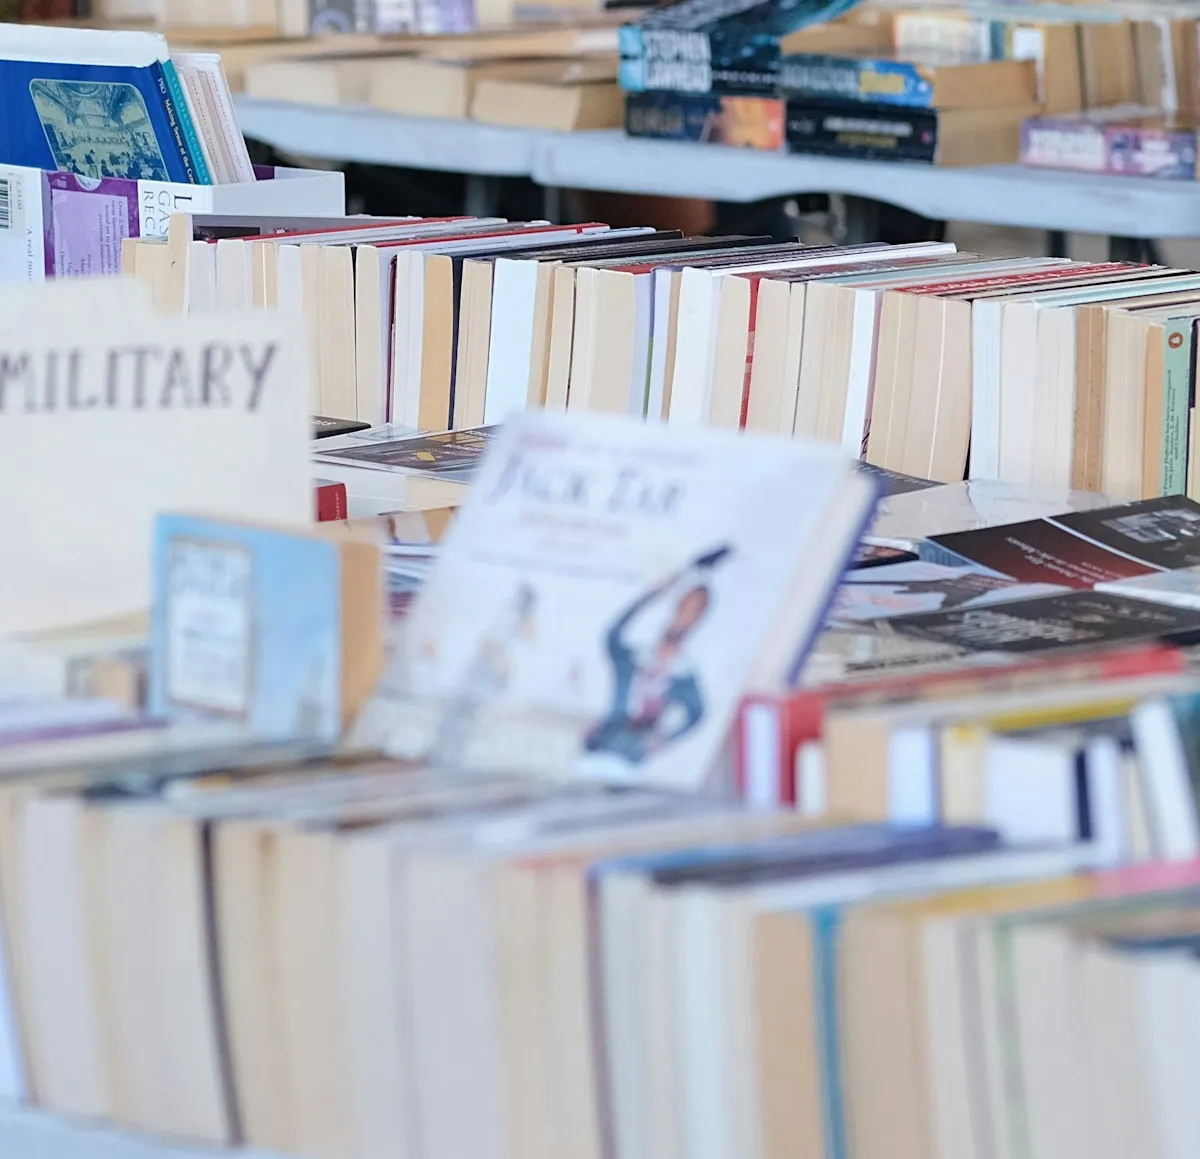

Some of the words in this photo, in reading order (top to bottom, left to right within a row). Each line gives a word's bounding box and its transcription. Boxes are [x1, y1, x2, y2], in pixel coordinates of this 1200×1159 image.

[164, 98, 176, 127] Making
[173, 126, 183, 146] Sense
[180, 147, 186, 156] of
[0, 338, 279, 415] MILITARY
